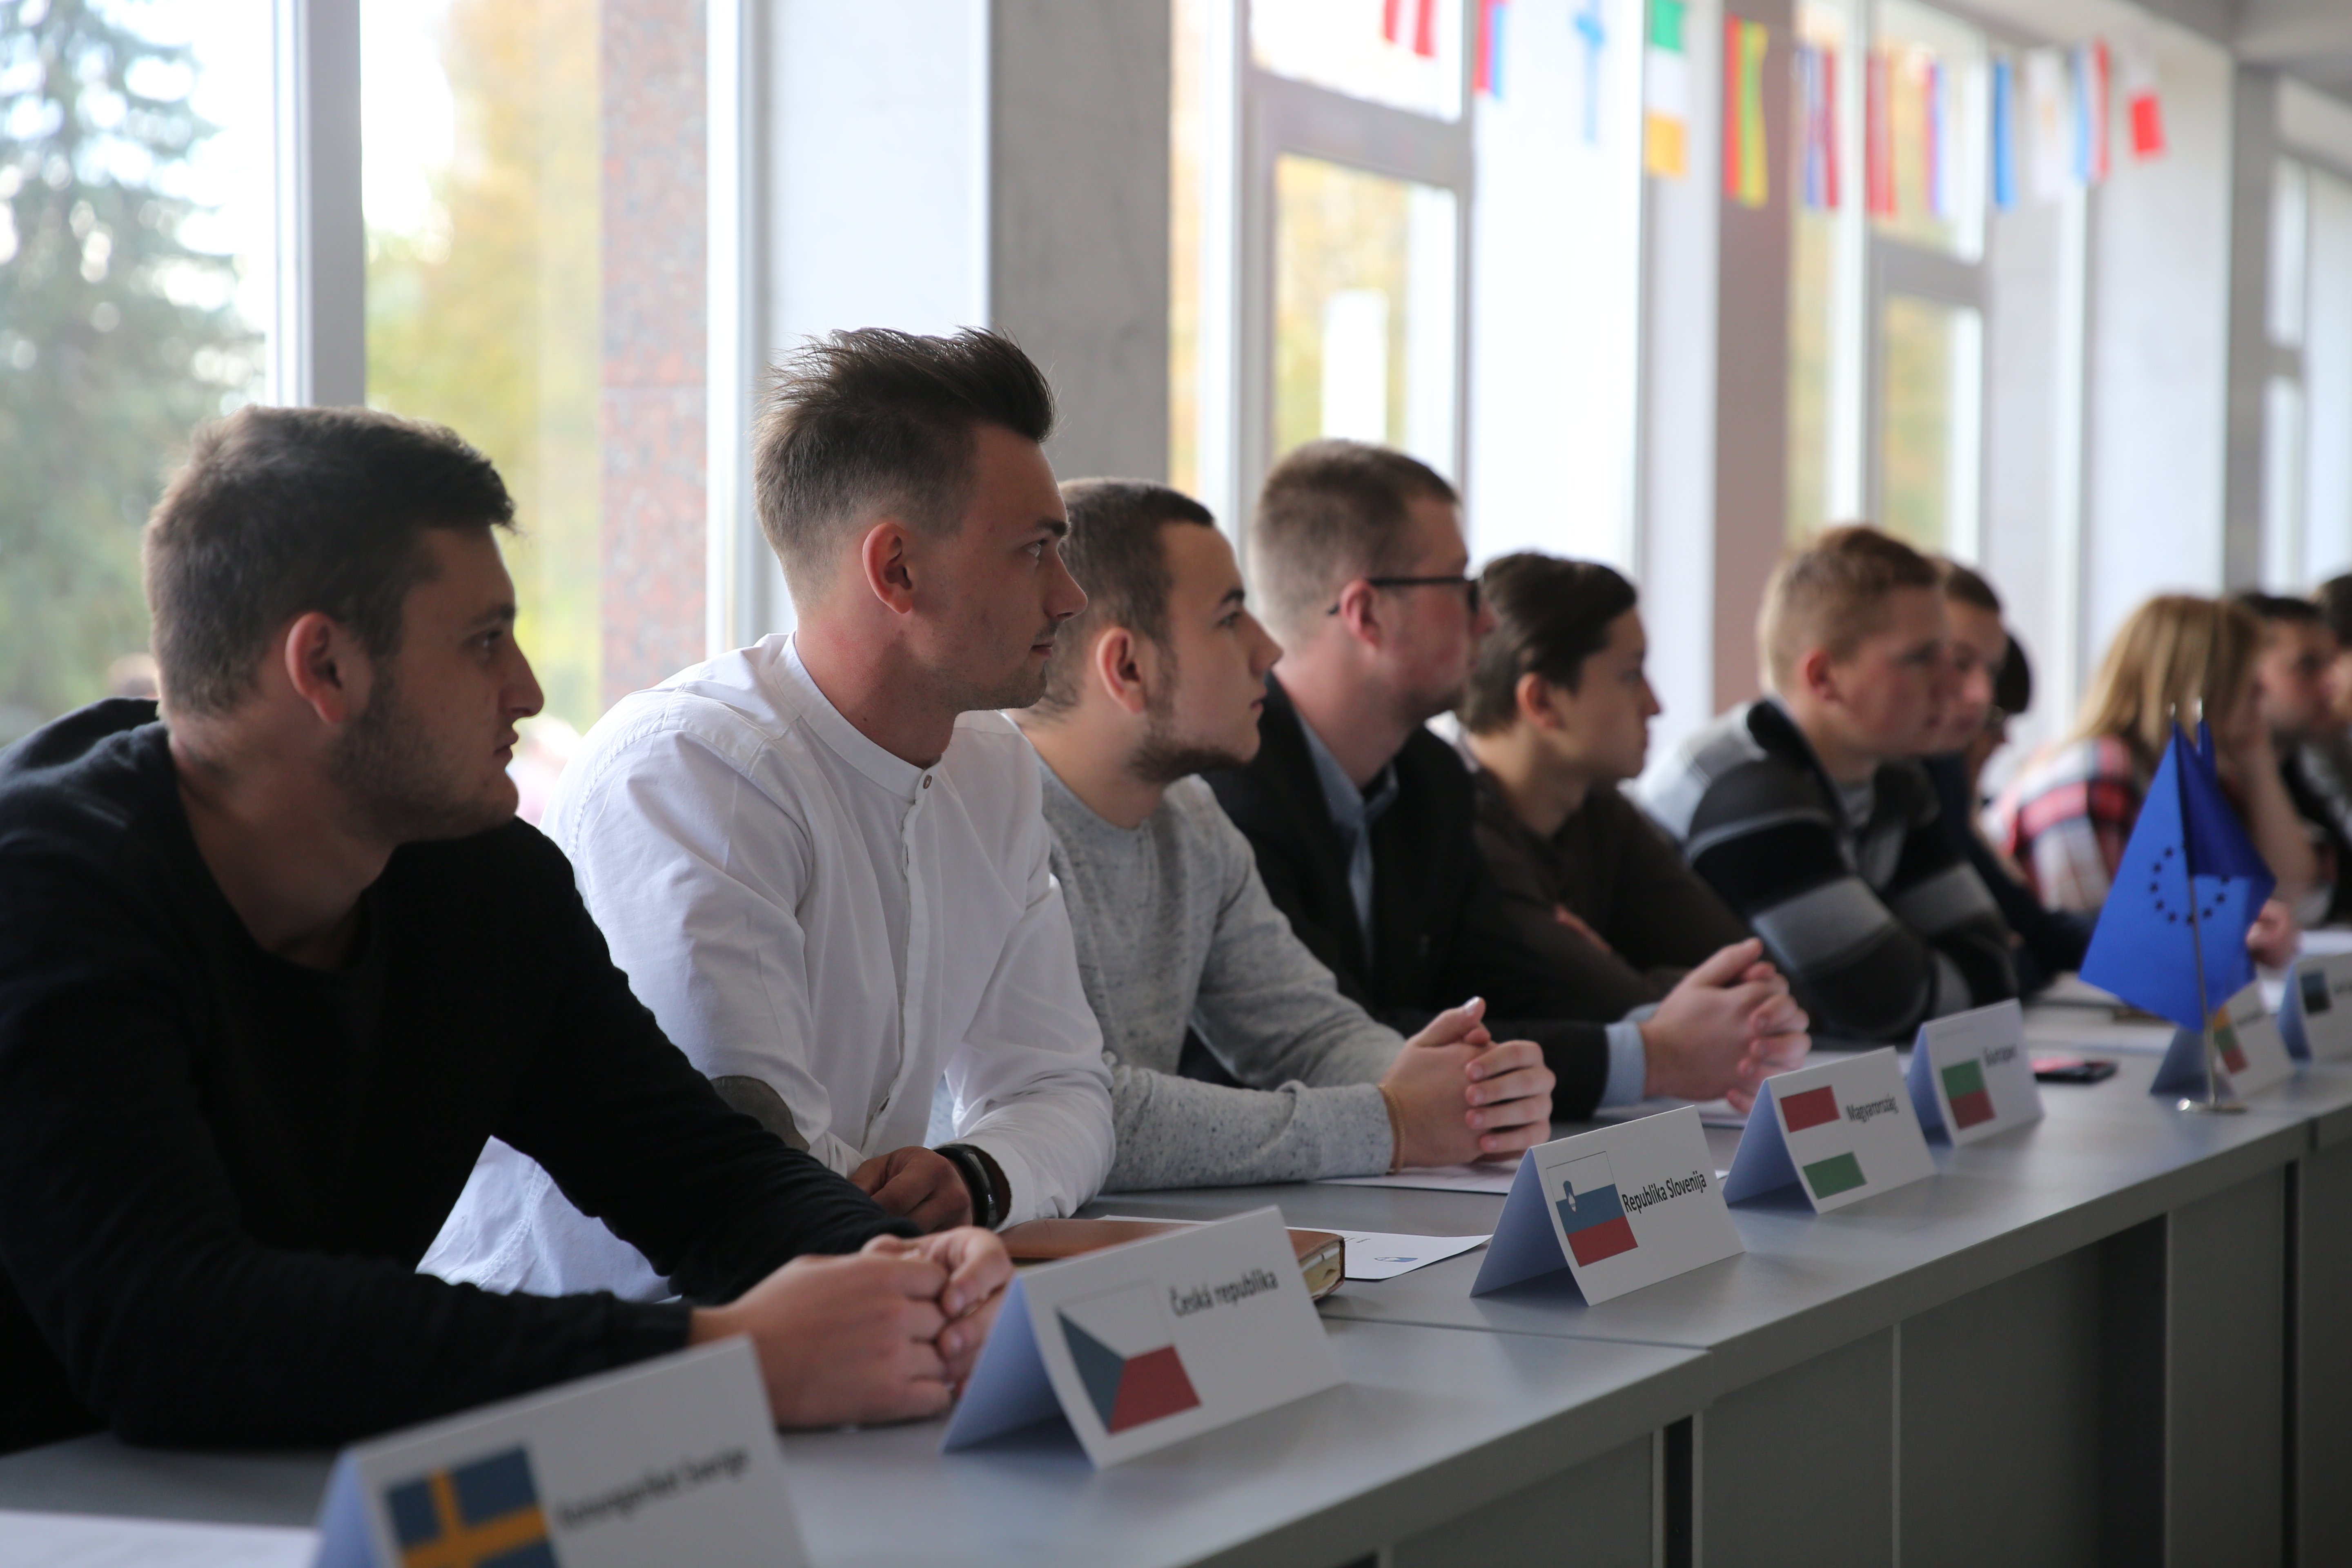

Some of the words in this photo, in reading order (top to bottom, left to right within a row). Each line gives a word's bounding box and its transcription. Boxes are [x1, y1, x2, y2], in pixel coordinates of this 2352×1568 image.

[1621, 1183, 1668, 1214] Republika
[1666, 1171, 1707, 1198] Slovenija
[1169, 1283, 1214, 1317] Česká
[1214, 1268, 1278, 1306] republika
